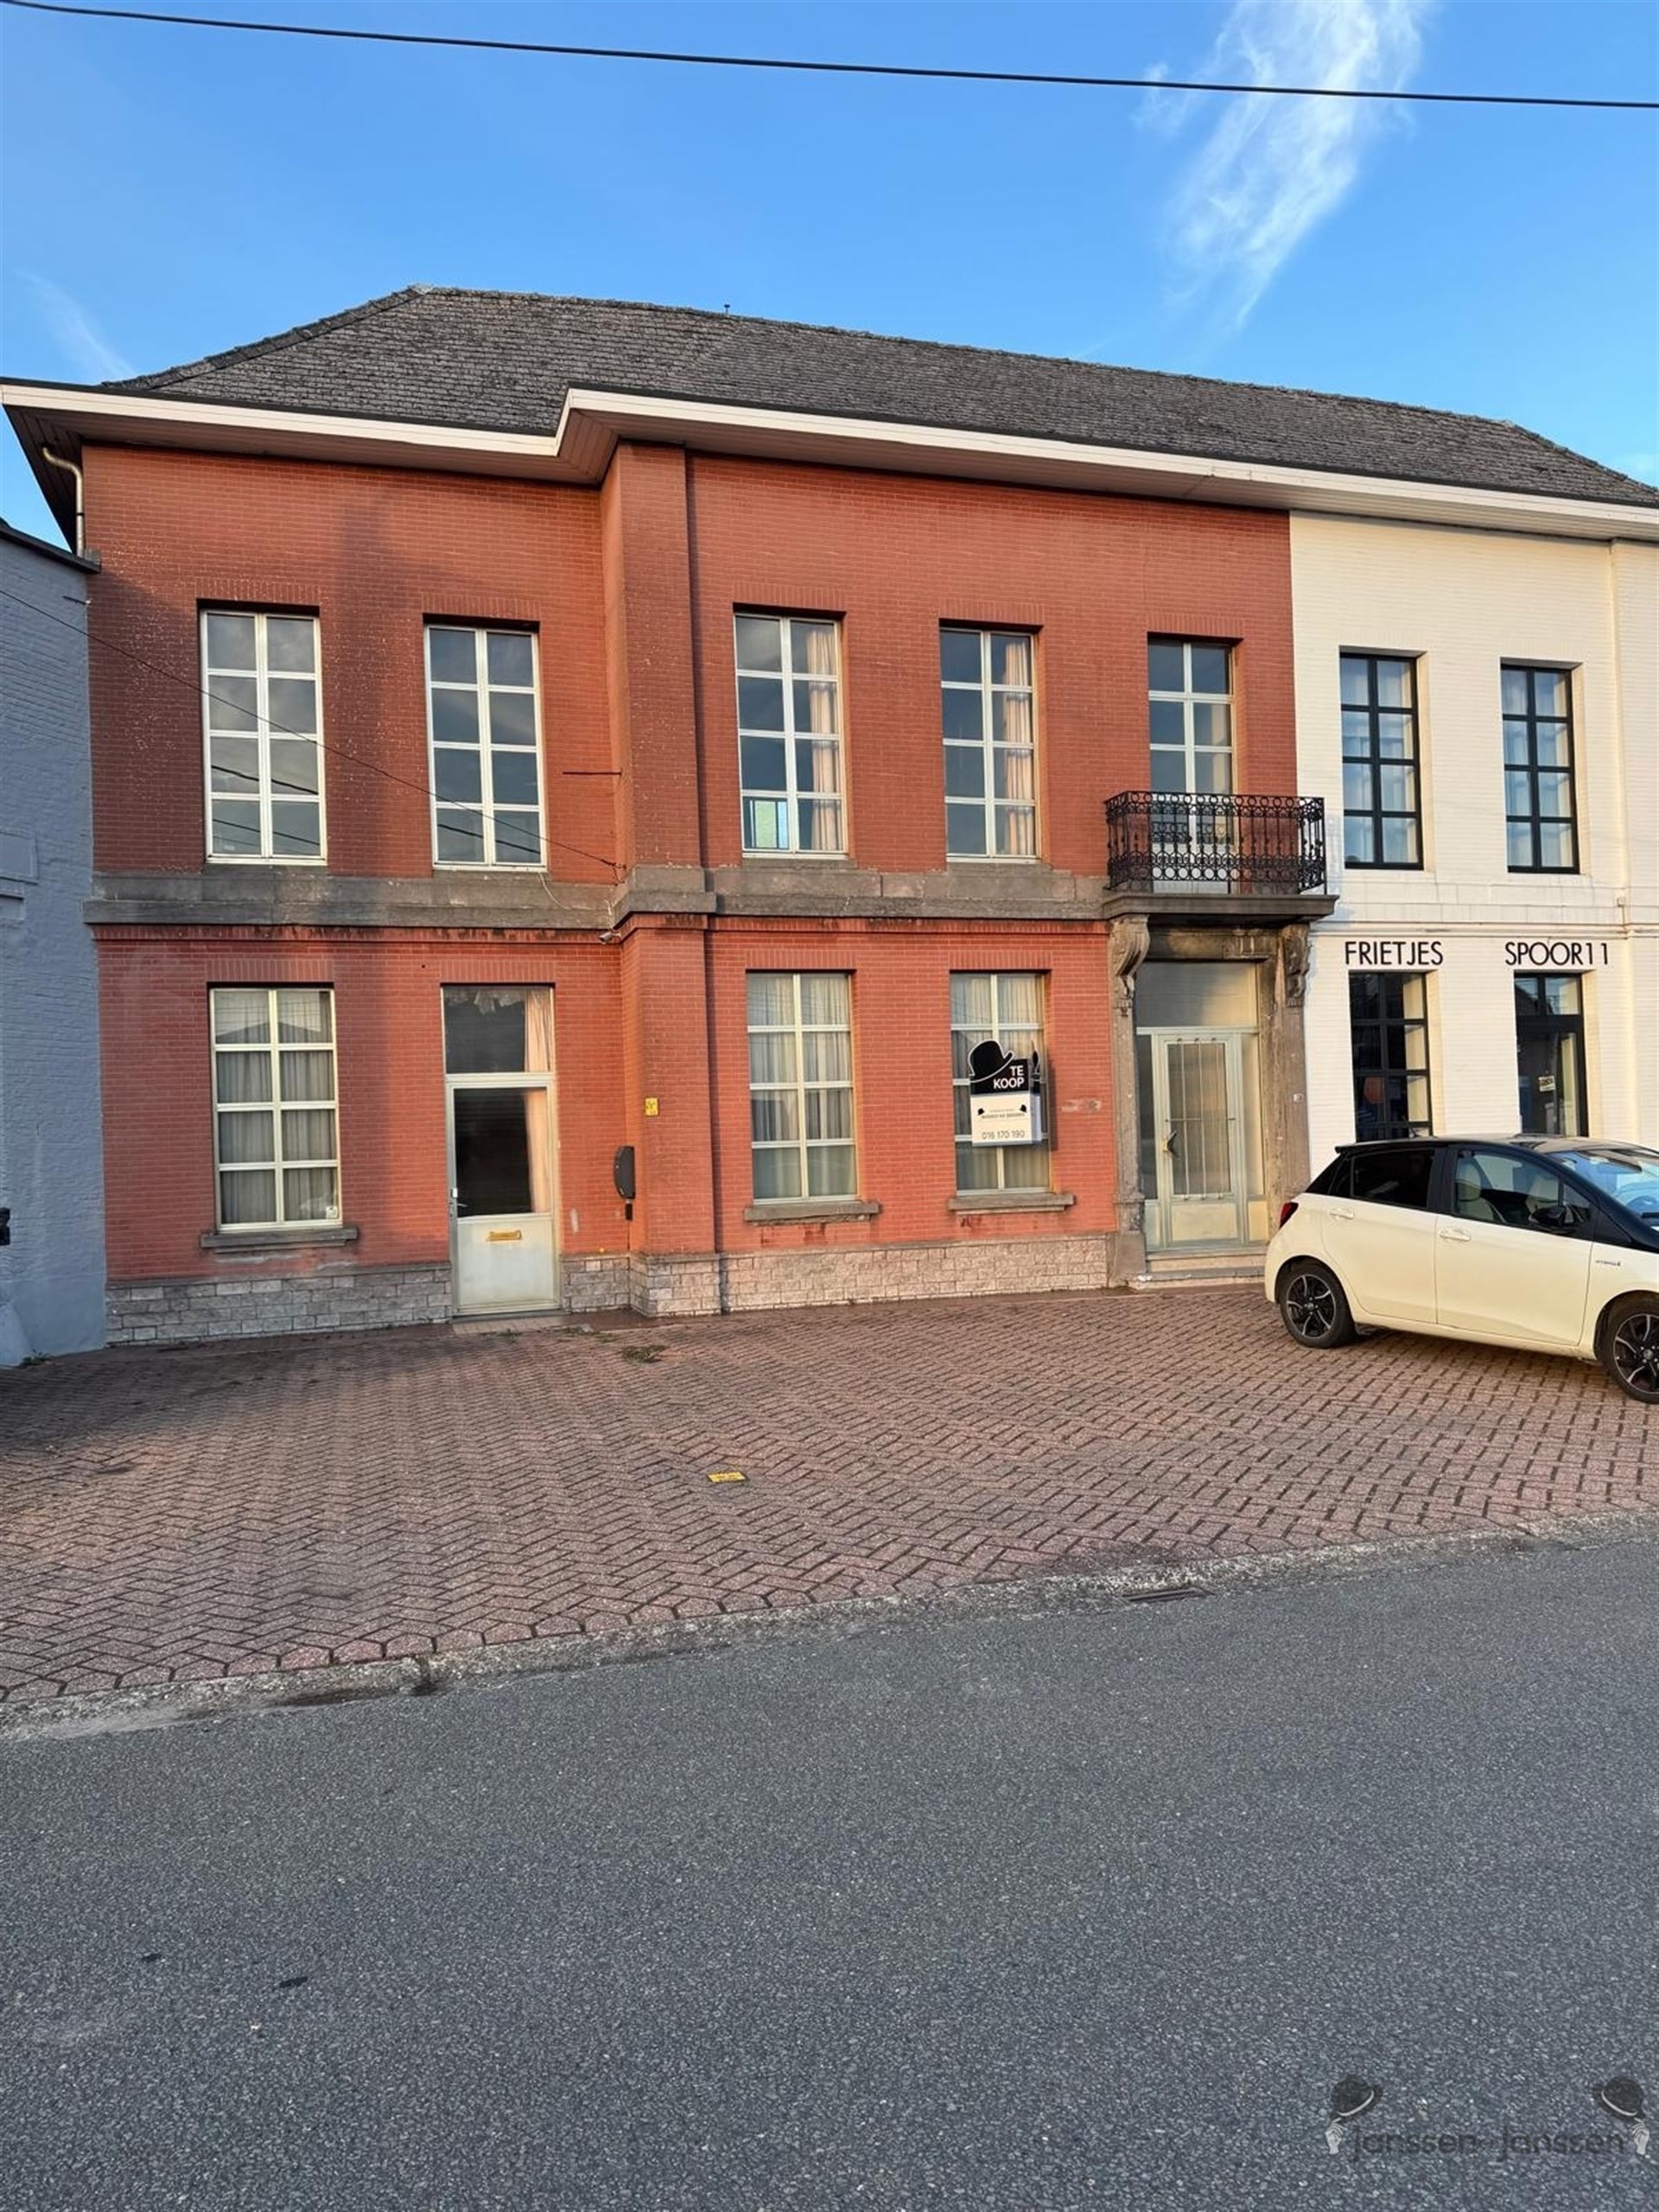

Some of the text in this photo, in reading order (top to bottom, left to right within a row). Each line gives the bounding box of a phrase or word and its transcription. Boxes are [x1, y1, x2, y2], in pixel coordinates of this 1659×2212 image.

[1344, 941, 1443, 965] FRIETJES
[1505, 942, 1608, 965] SPOOR11
[1009, 1065, 1024, 1077] TE
[993, 1077, 1025, 1090] KOOP
